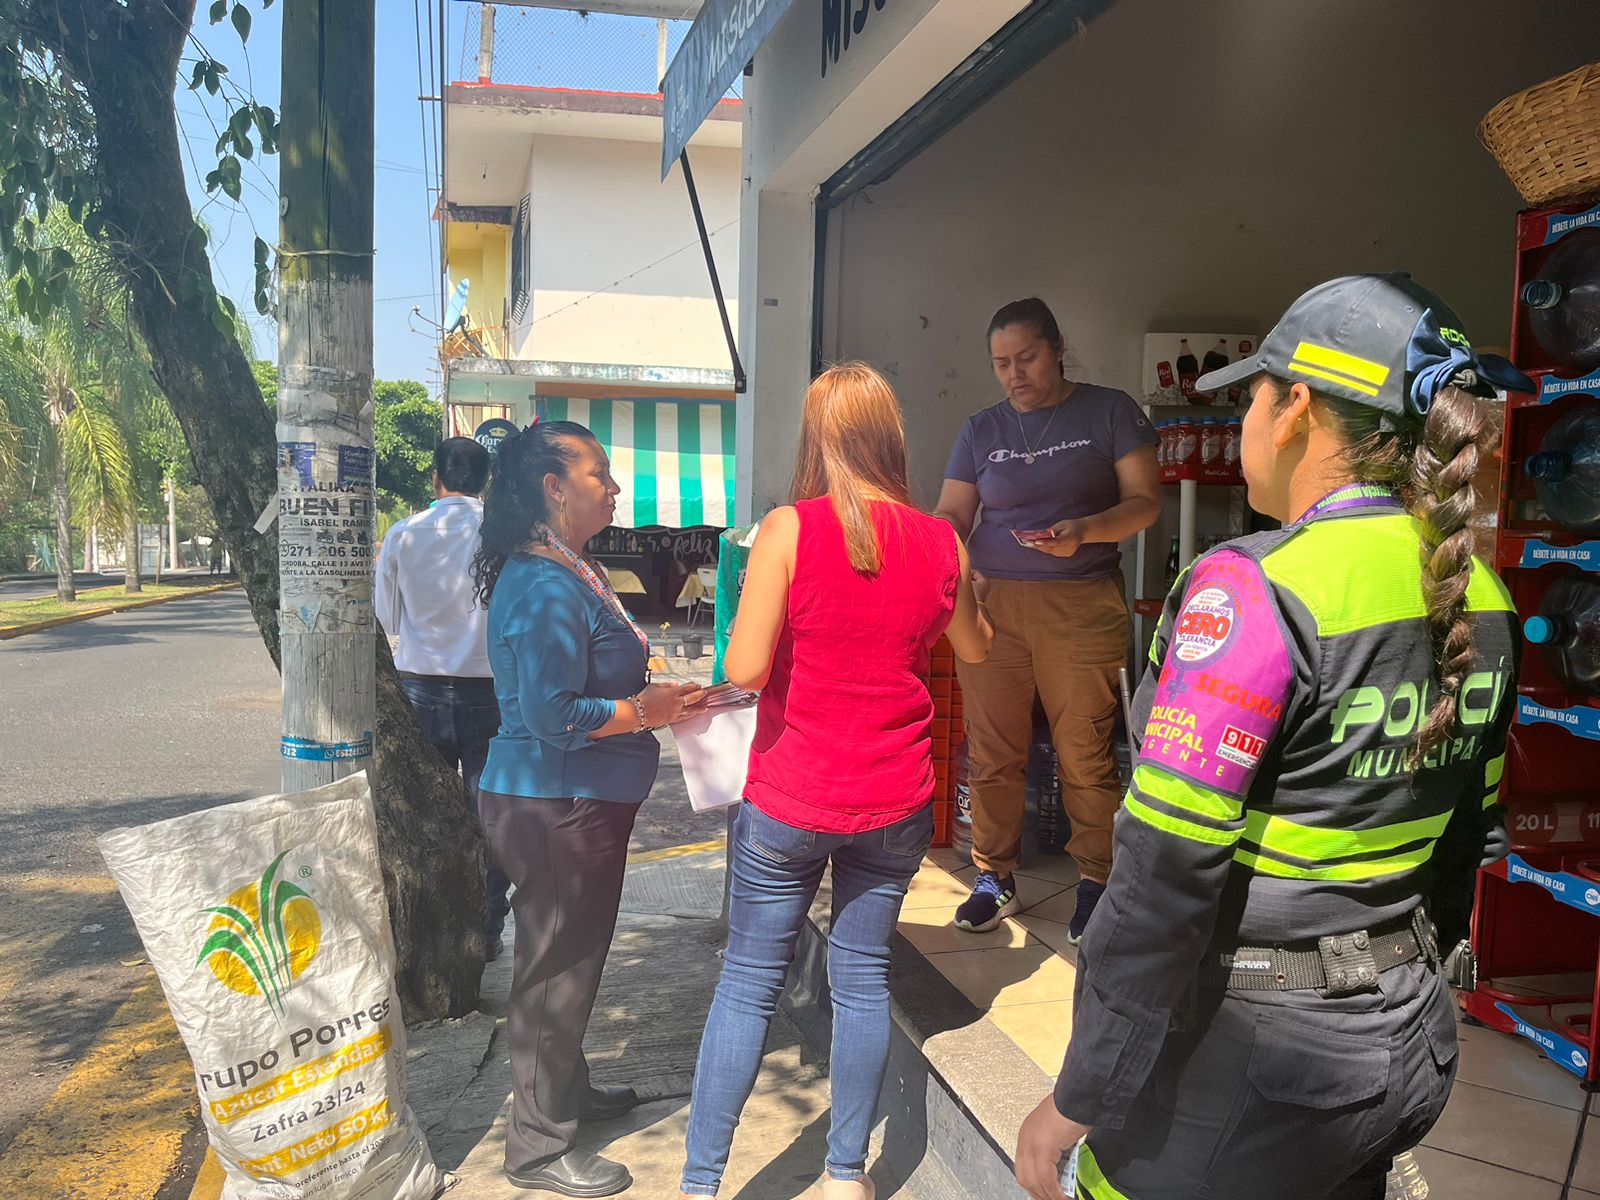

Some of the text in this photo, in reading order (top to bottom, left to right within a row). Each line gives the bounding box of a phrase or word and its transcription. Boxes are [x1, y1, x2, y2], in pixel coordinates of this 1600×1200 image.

[1569, 218, 1575, 228] LA
[1576, 215, 1587, 226] VIDA
[1561, 382, 1567, 392] LA
[1568, 380, 1579, 391] VIDA
[1580, 380, 1587, 389] EN
[988, 437, 1091, 463] Champion
[279, 498, 339, 516] BUEN
[301, 518, 339, 527] ISABEL
[290, 546, 312, 557] 271
[1550, 550, 1556, 559] LA
[1557, 550, 1568, 559] VIDA
[1569, 550, 1576, 560] EN
[1577, 550, 1590, 560] CASA
[1178, 611, 1231, 641] CERO
[1195, 673, 1282, 721] SEGURA
[1150, 706, 1197, 730] POLICÍA
[1539, 708, 1545, 718] LA
[1546, 709, 1557, 720] VIDA
[1557, 711, 1565, 721] EN
[1566, 713, 1578, 725] CASA
[1226, 731, 1263, 756] 911
[1515, 814, 1540, 831] 20
[1543, 814, 1555, 830] L
[1528, 870, 1533, 880] LA
[1533, 872, 1544, 884] VIDA
[1545, 876, 1552, 887] EN
[1552, 879, 1565, 892] CASA
[289, 996, 390, 1058] Porres
[1518, 1023, 1555, 1050] LA VIDA EN CASA
[213, 1080, 287, 1120] Azúcar
[250, 1080, 367, 1143] Zafra 23/24
[290, 1134, 336, 1163] Neto
[338, 1115, 367, 1139] 50
[339, 1151, 361, 1166] hasta
[362, 1145, 370, 1155] el
